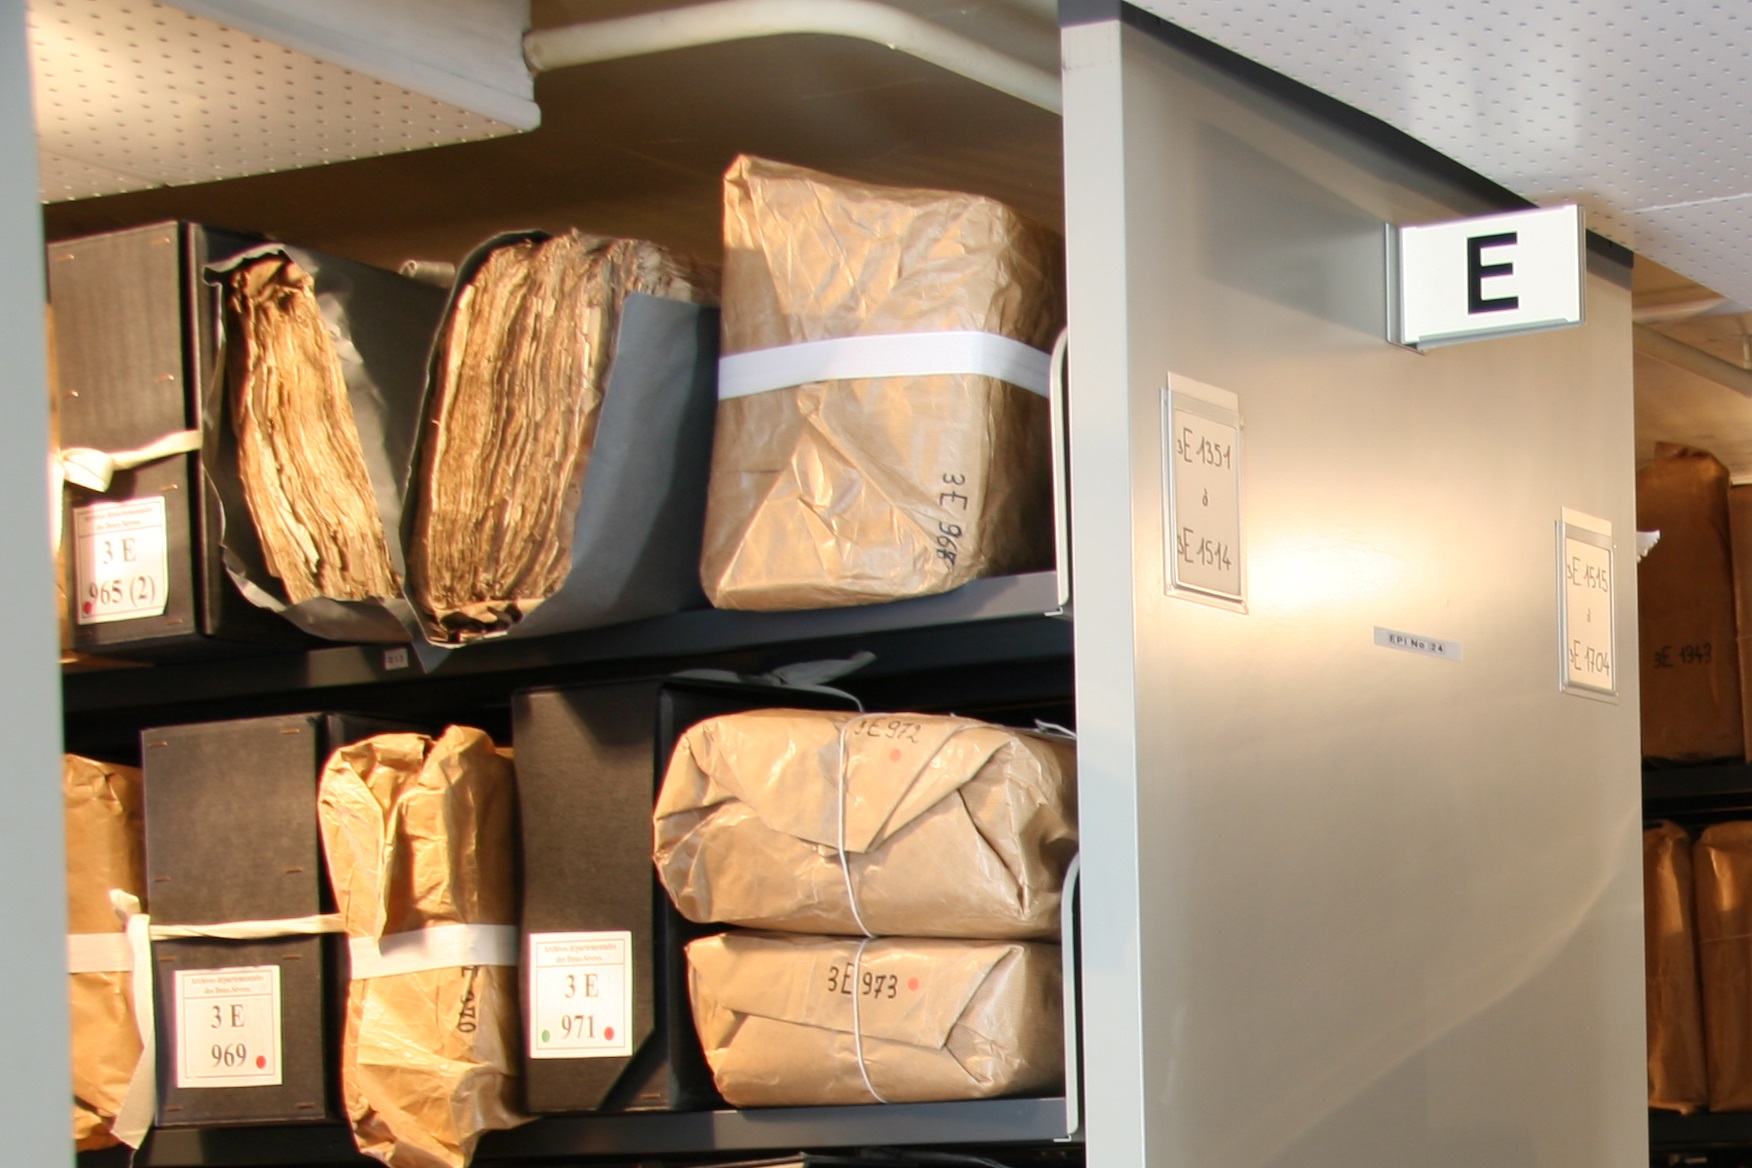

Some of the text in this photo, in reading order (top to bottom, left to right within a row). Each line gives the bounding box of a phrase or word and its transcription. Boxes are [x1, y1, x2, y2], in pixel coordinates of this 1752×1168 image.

[1467, 231, 1519, 315] E
[1196, 436, 1231, 470] 1351
[103, 538, 137, 564] 3 E
[1197, 537, 1231, 571] 1514
[1585, 645, 1610, 677] 1704
[564, 973, 599, 998] 3 E
[862, 967, 898, 999] 973
[211, 1004, 245, 1029] 3 E
[561, 1014, 595, 1039] 971
[211, 1043, 247, 1068] 969
